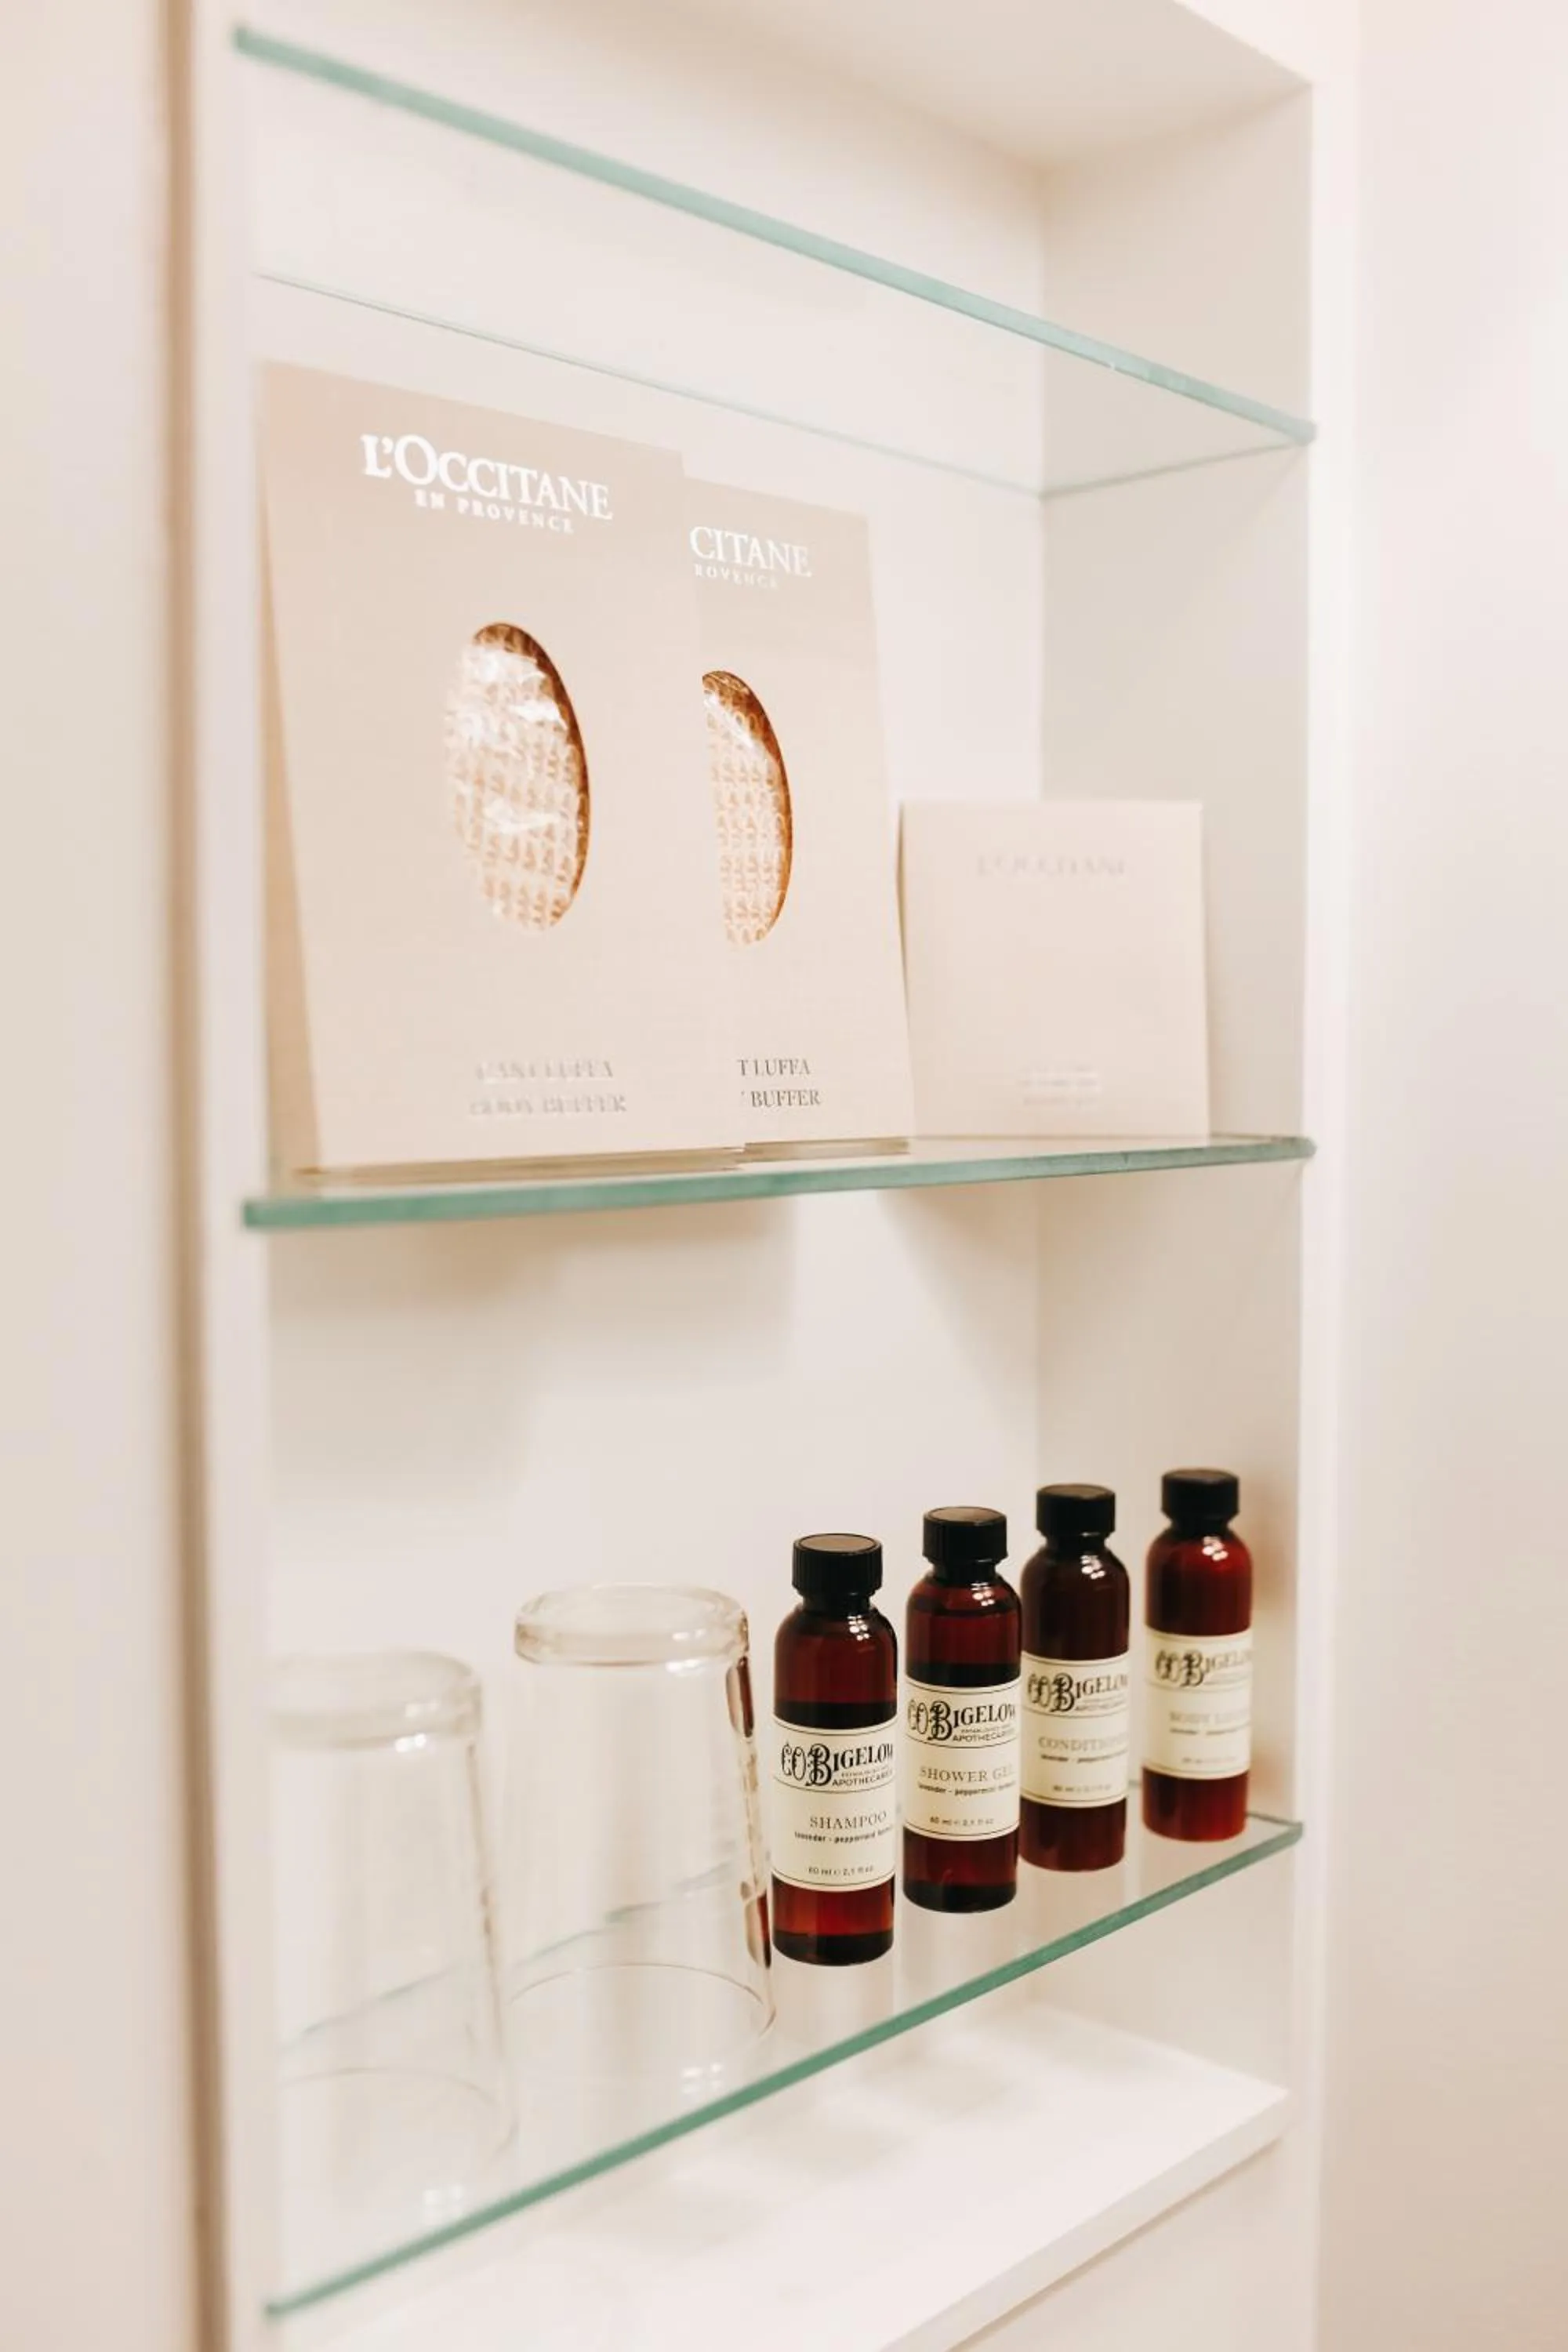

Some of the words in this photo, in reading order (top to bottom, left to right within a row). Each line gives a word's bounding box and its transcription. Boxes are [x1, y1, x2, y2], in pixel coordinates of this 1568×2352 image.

[360, 433, 614, 521] L'OCCITANE
[414, 488, 446, 510] EN
[456, 496, 575, 535] PROVENCE
[750, 1088, 822, 1109] BUFFER
[919, 1765, 989, 1784] SHOWER
[809, 1810, 887, 1831] SHAMPOO
